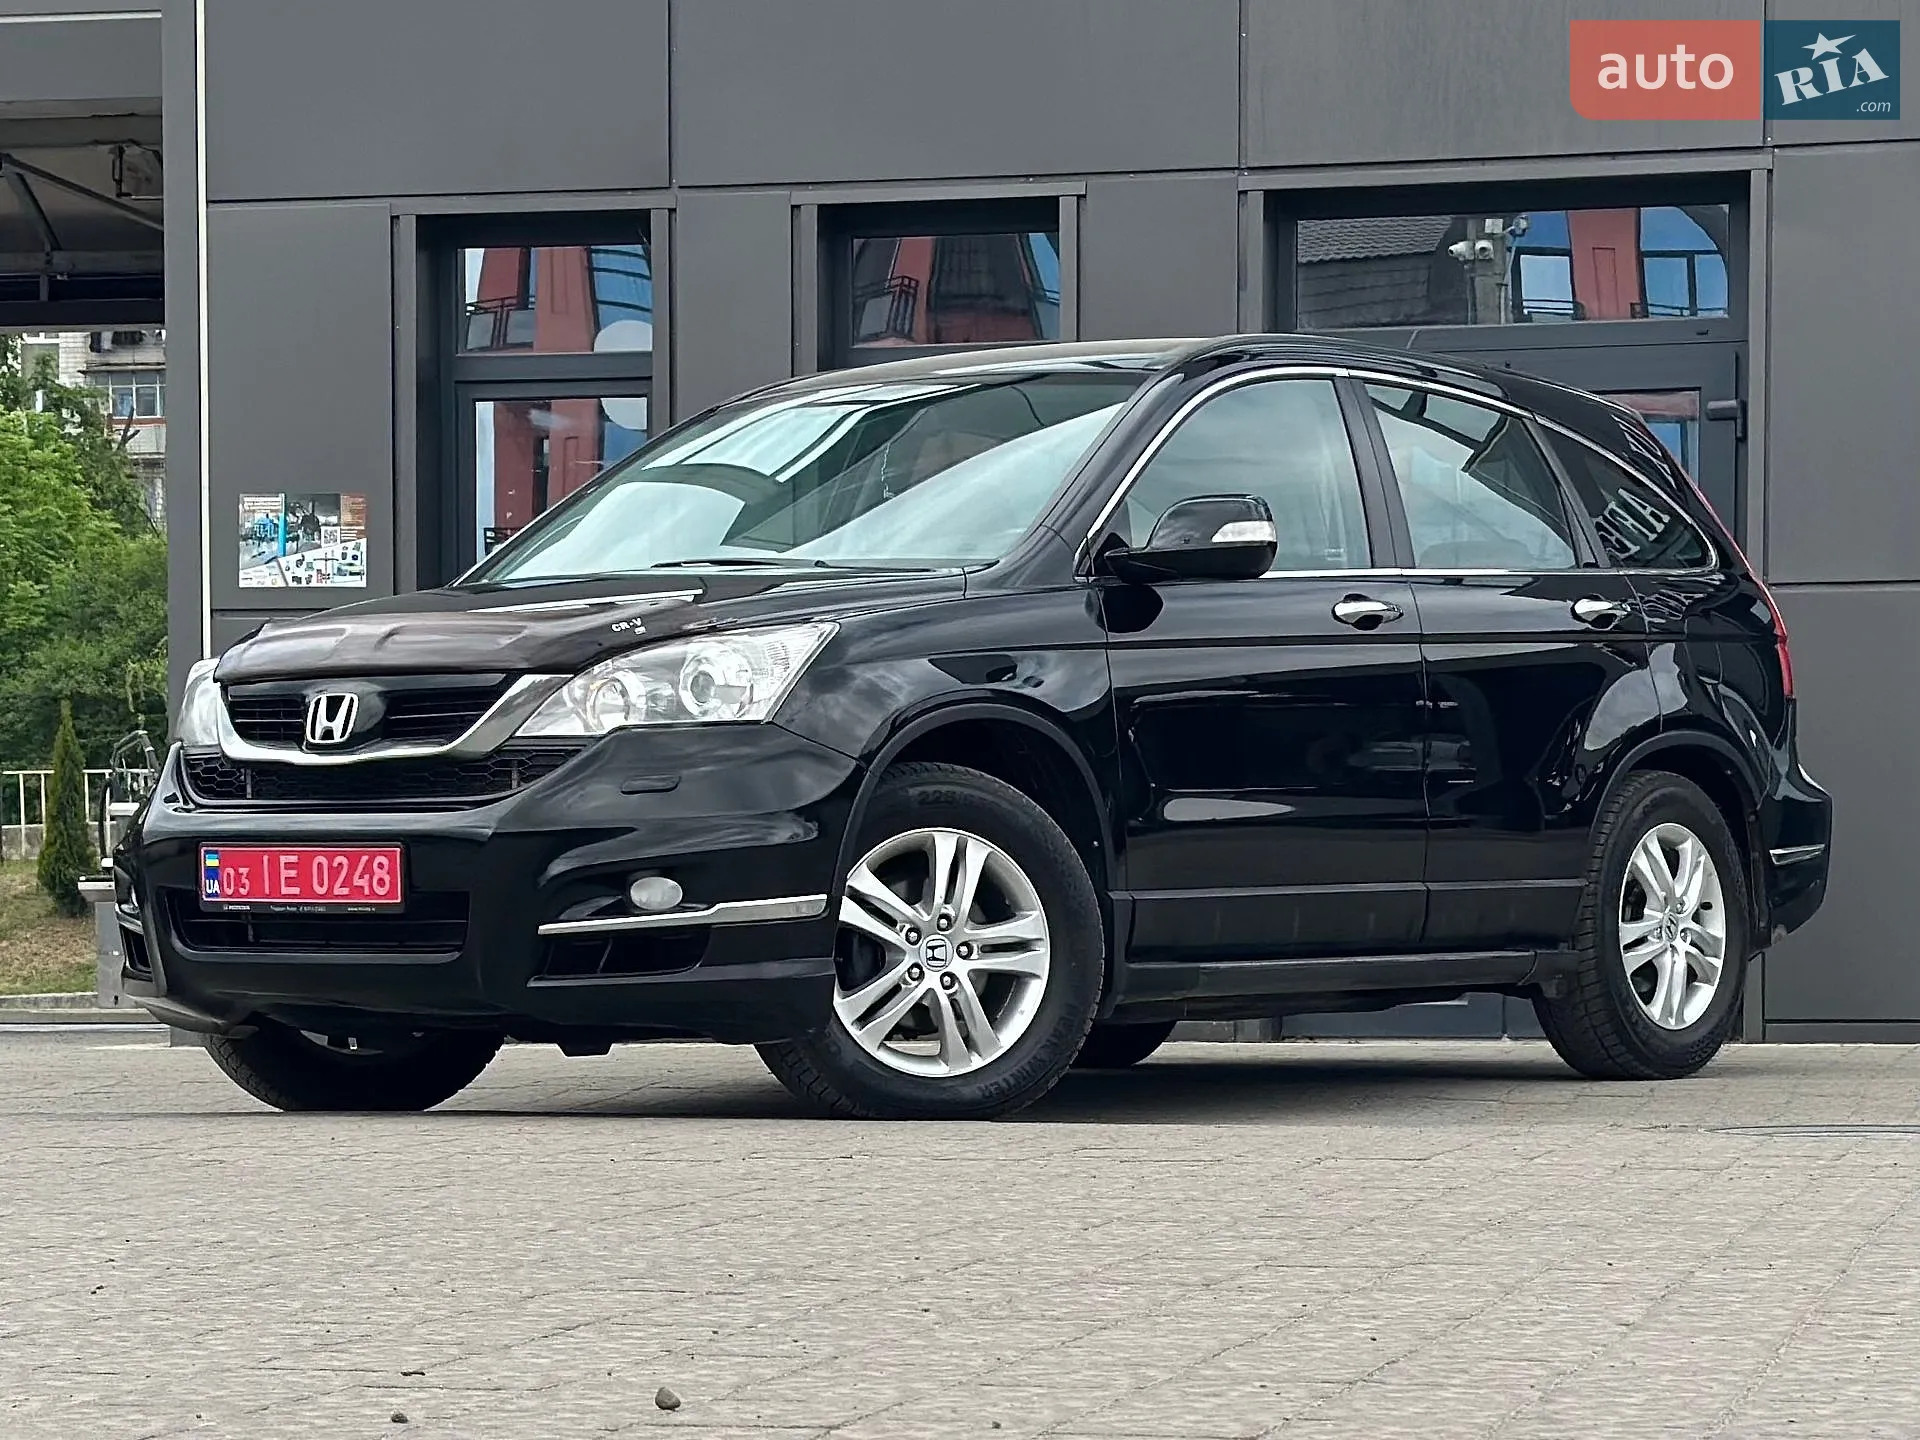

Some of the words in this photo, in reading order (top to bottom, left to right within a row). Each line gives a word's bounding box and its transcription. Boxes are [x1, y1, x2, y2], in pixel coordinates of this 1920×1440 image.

[611, 617, 643, 632] CR-V
[205, 879, 220, 894] UA
[223, 867, 250, 896] 03
[311, 855, 391, 896] 0248
